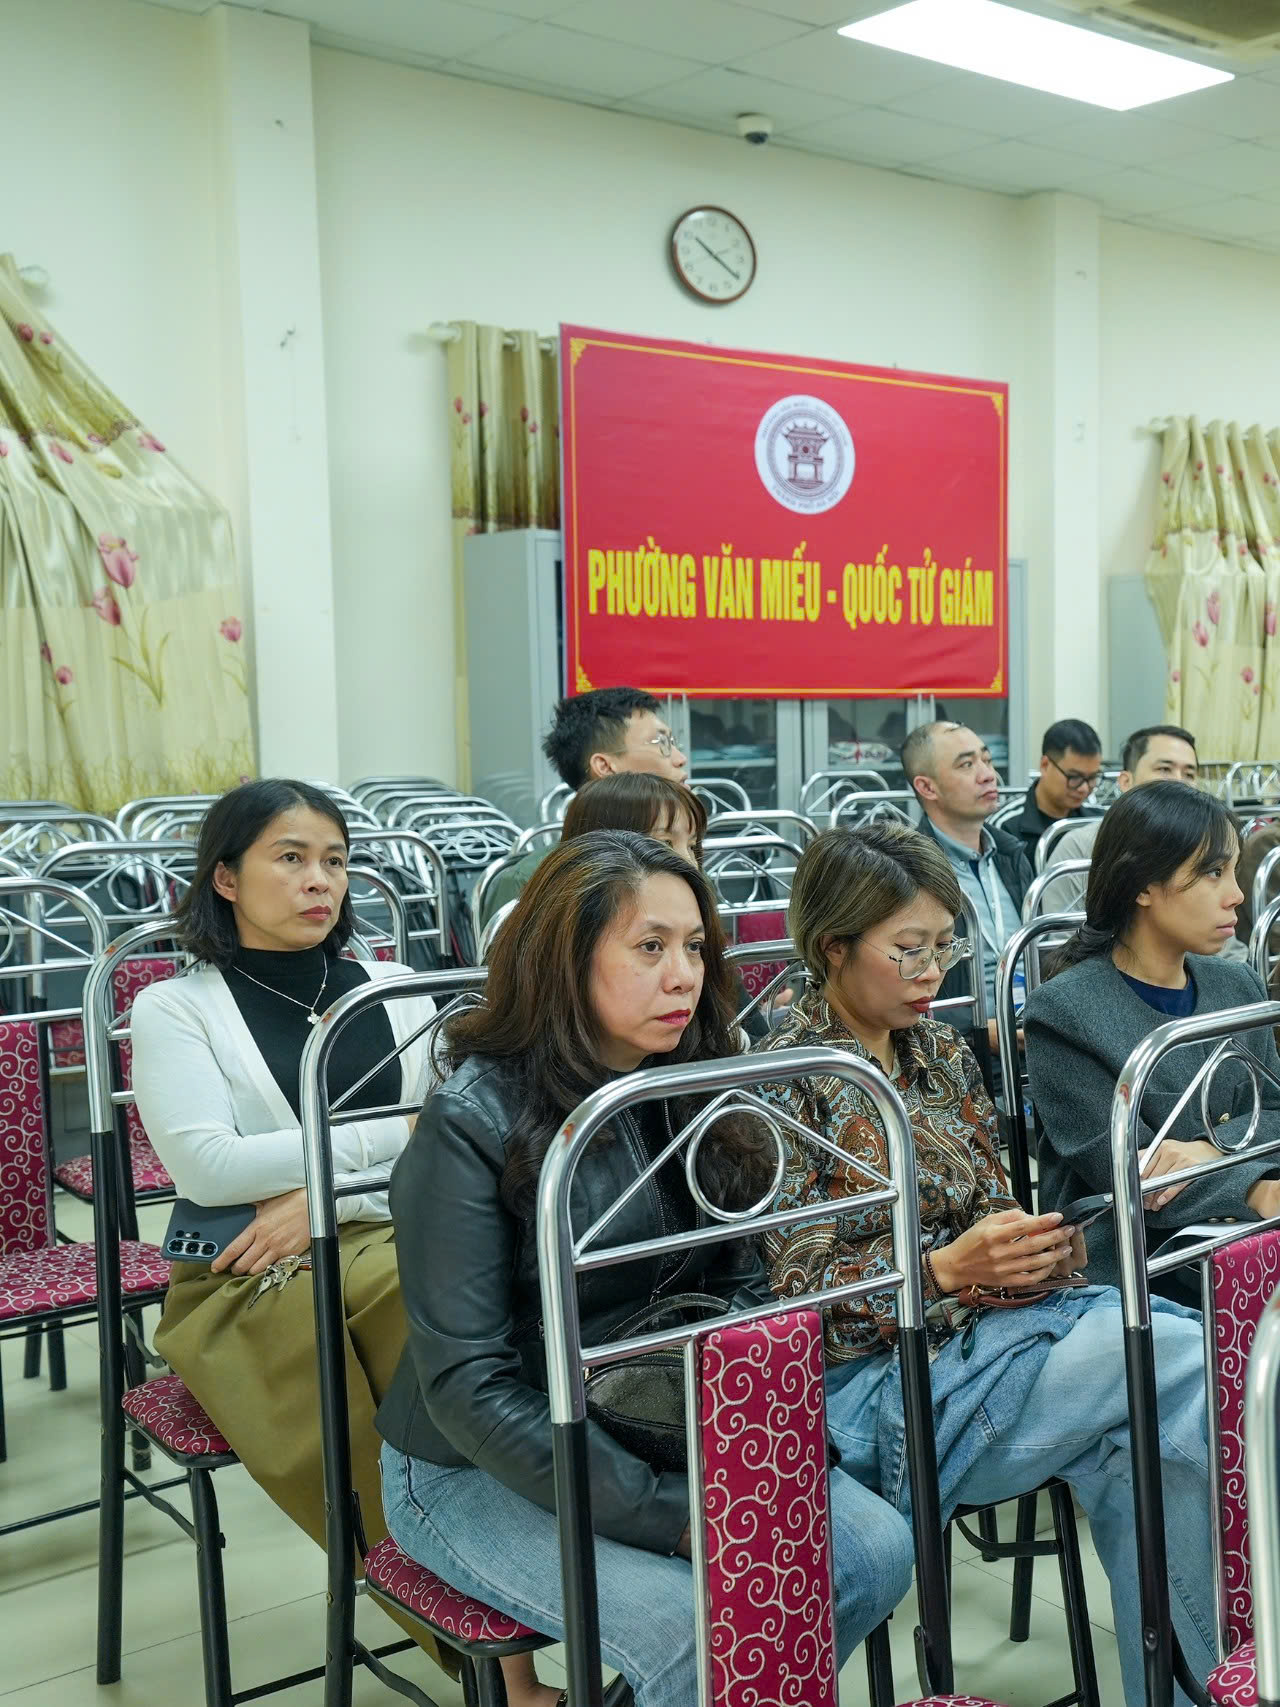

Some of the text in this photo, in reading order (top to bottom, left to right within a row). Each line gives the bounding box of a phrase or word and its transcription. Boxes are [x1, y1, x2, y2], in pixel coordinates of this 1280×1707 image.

[588, 536, 697, 618] PHƯỜNG
[703, 543, 755, 620] VĂN
[760, 541, 821, 622] MIẾU
[842, 544, 903, 630] QUỐC
[907, 547, 938, 625] TỬ
[940, 557, 995, 627] GIÁM
